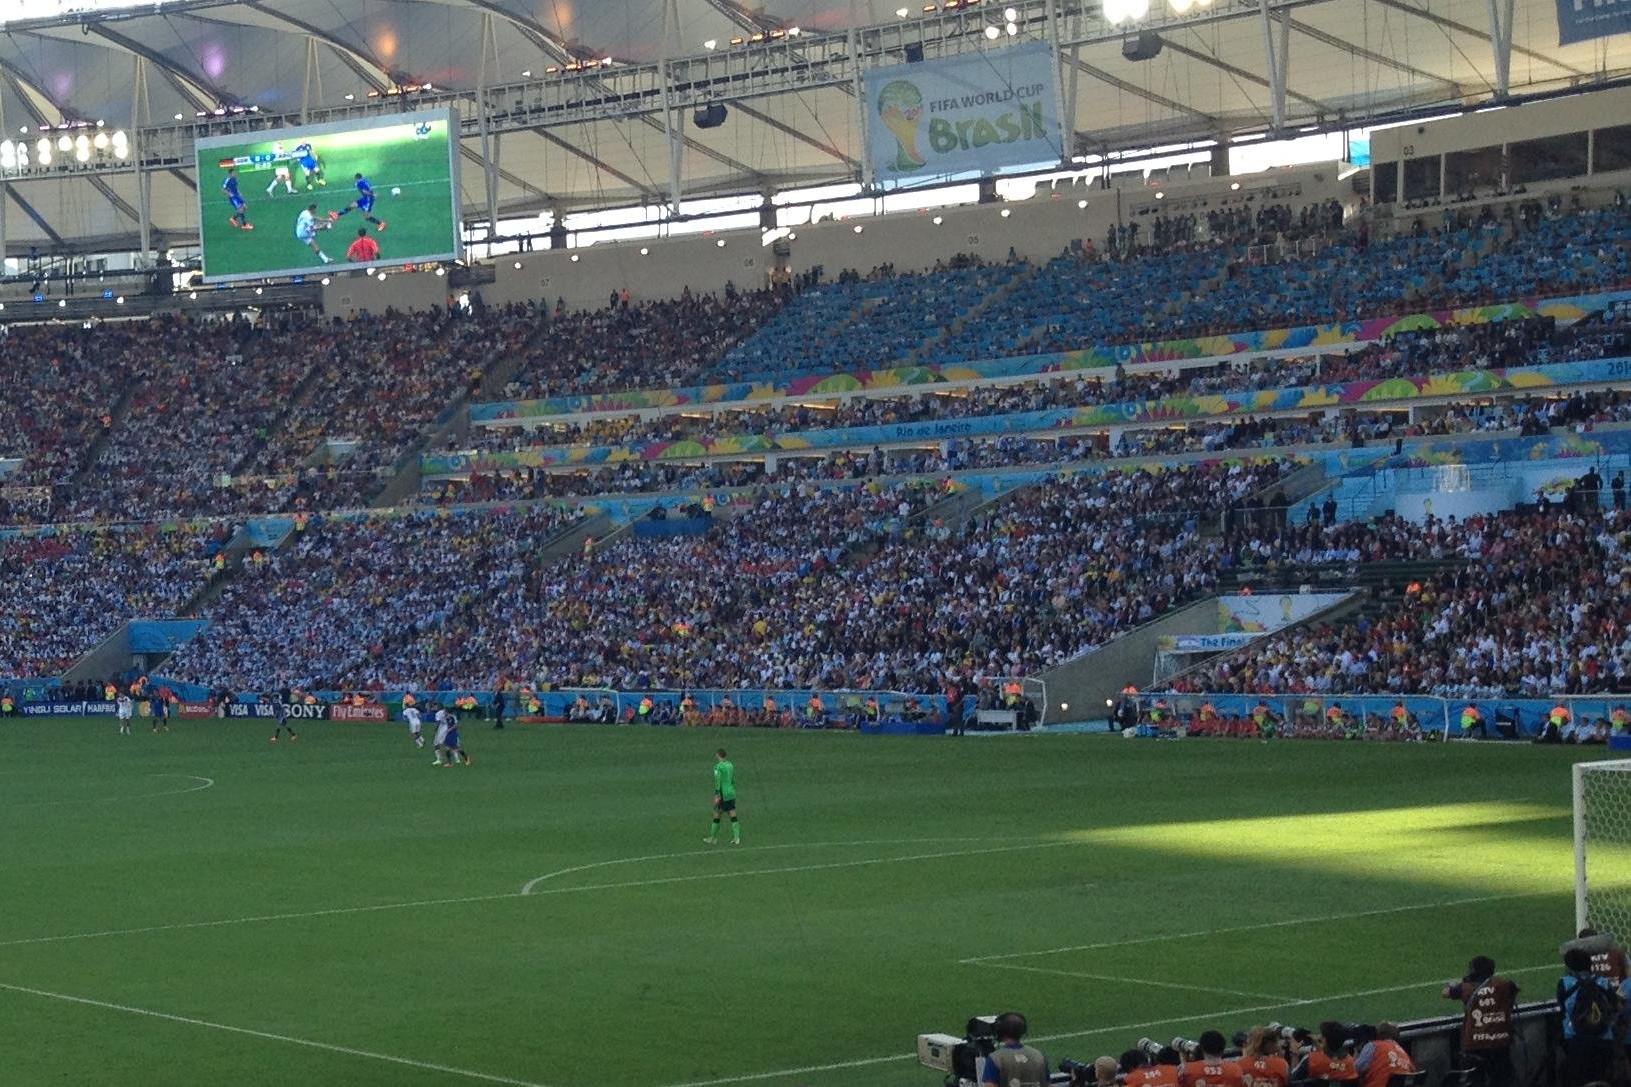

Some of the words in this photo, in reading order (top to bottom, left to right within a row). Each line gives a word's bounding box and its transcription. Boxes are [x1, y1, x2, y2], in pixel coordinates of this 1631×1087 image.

[929, 98, 960, 112] FIFA
[961, 89, 1015, 108] WORLD
[1016, 83, 1045, 99] CUP
[928, 100, 1047, 154] Brasil
[896, 427, 913, 437] Rio
[917, 427, 930, 436] de
[935, 423, 971, 434] Janeiro
[1201, 638, 1219, 647] The
[229, 704, 248, 716] VISA
[254, 704, 275, 716] VISA
[283, 704, 326, 718] SONY
[332, 705, 346, 719] Fly
[347, 706, 384, 719] Emirates
